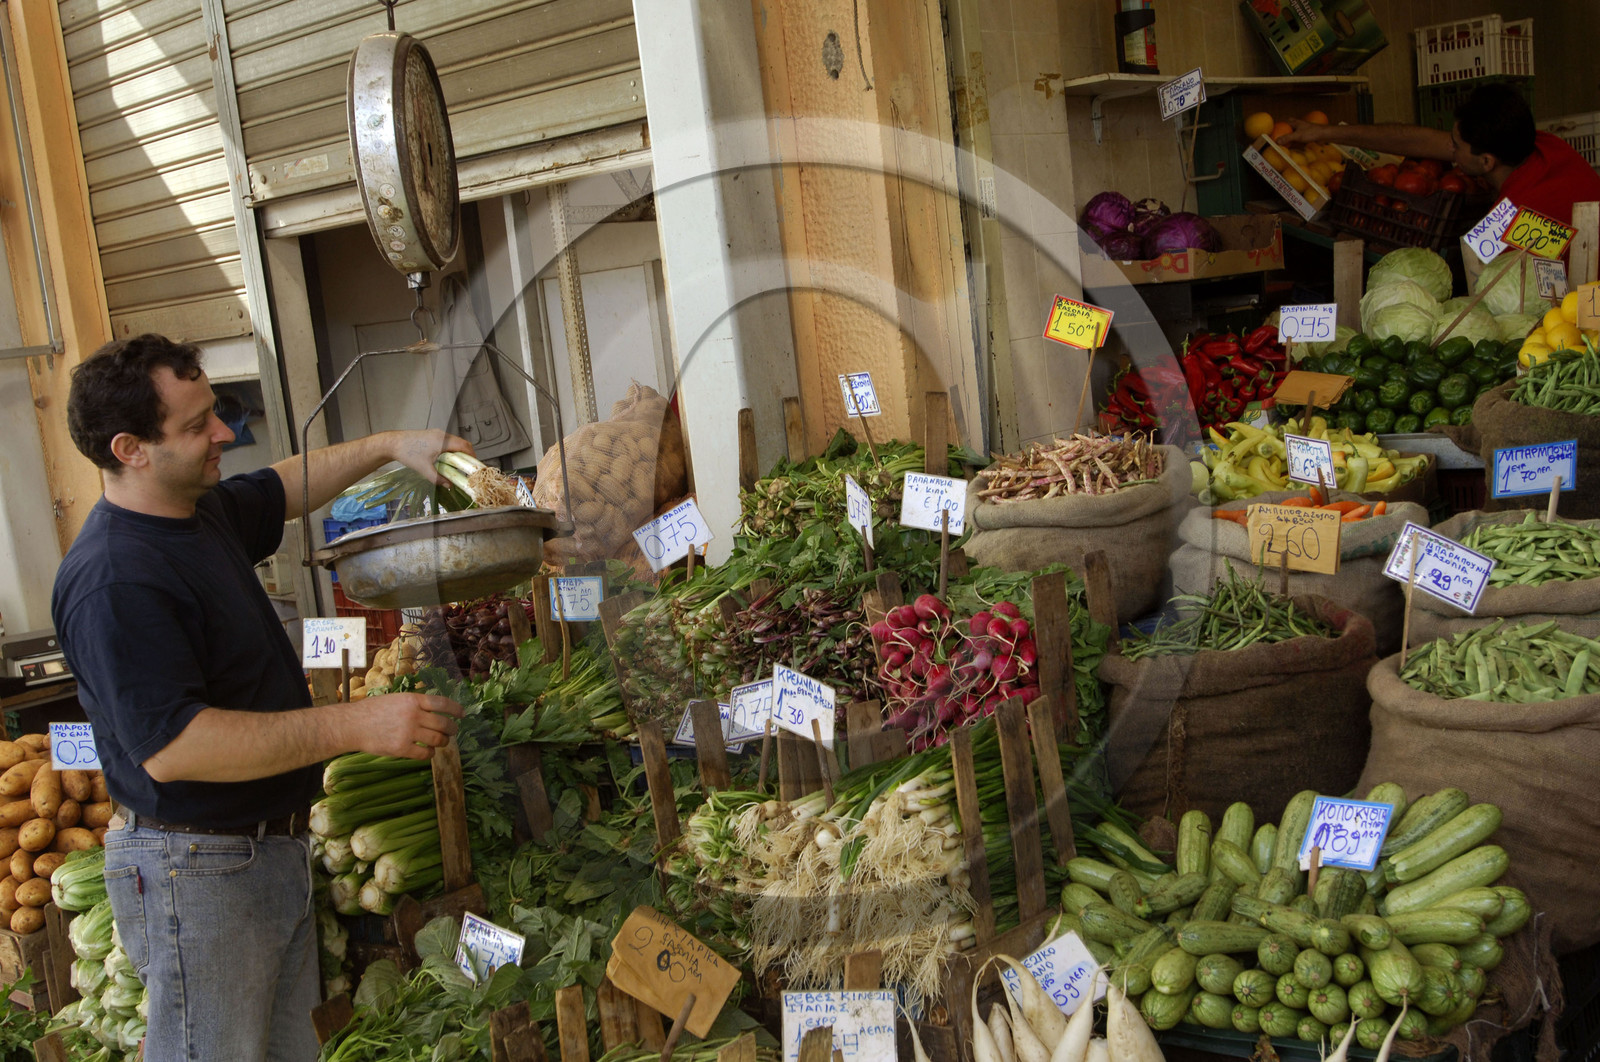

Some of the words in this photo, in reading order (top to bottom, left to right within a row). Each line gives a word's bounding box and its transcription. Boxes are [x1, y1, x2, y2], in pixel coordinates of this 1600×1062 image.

[1520, 470, 1537, 483] 70
[644, 514, 697, 560] 0.75
[311, 635, 336, 658] 1.10
